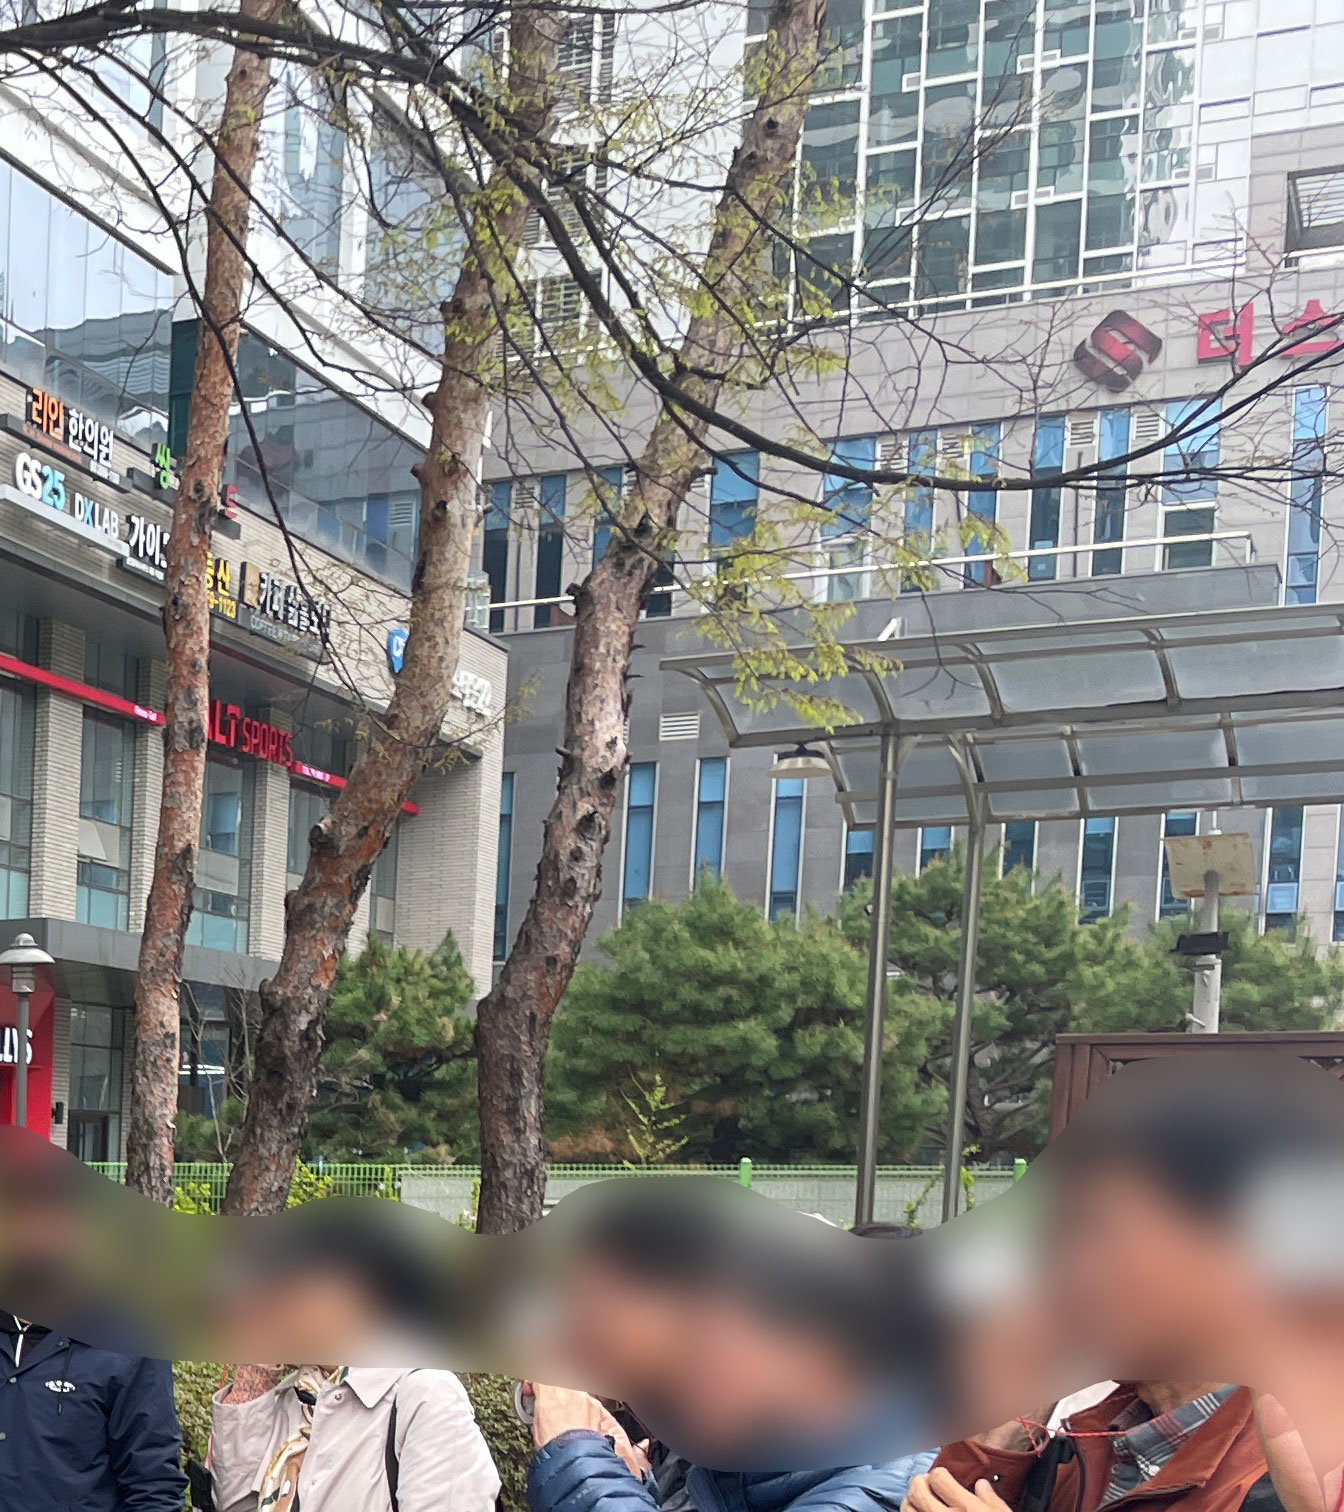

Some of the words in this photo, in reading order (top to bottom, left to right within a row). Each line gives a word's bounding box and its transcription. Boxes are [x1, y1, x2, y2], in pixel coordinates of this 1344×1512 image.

[68, 408, 114, 468] 한의원
[15, 452, 66, 510] GS25
[241, 717, 294, 767] SPORTS
